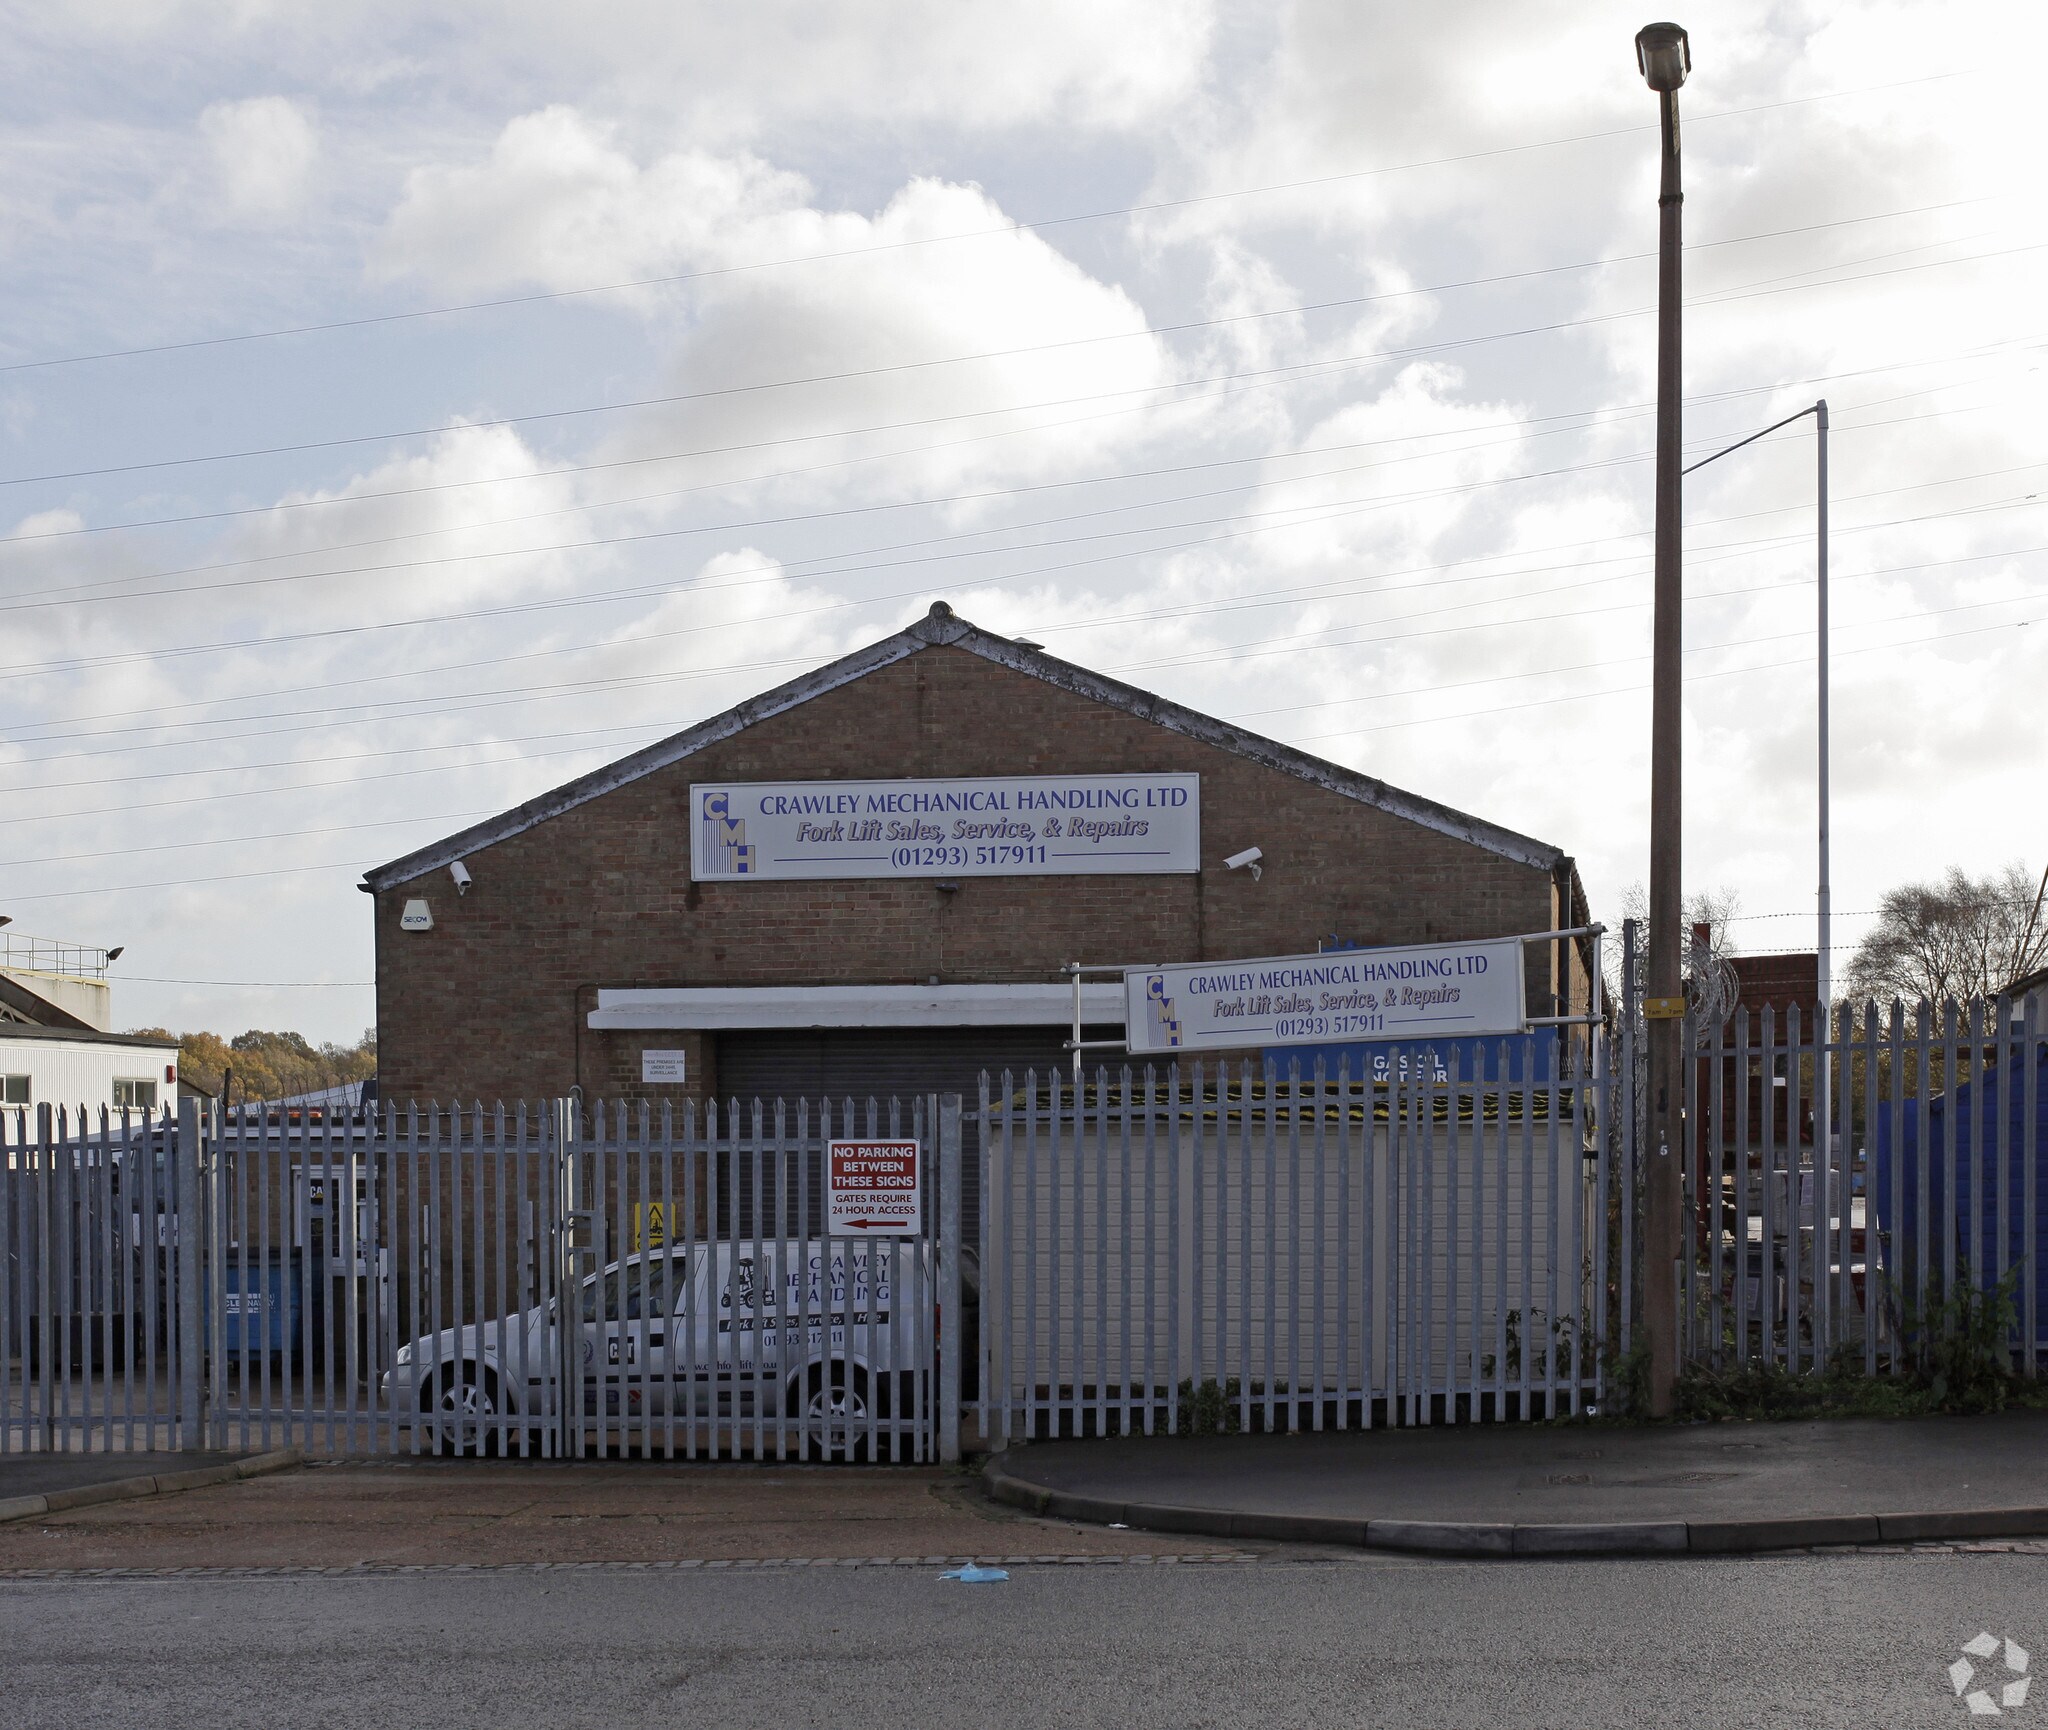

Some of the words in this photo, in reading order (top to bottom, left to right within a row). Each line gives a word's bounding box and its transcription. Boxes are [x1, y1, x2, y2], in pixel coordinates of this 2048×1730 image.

[760, 794, 860, 815] CRAWLEY
[866, 791, 1010, 813] MECHANICAL
[1017, 788, 1139, 810] HANDLING
[1146, 787, 1188, 807] LTD
[796, 819, 845, 842] Fork
[847, 818, 883, 842] Lift
[885, 817, 946, 844] Sales,
[951, 816, 1036, 842] Service,
[1041, 816, 1063, 838] &
[1066, 814, 1150, 843] Repairs
[891, 846, 968, 869] (01293)
[975, 845, 1046, 865] 517911
[1189, 973, 1256, 994] CRAWLEY
[1259, 965, 1359, 989] MECHANICAL
[1364, 957, 1452, 982] HANDLING
[1457, 955, 1488, 975] LTD
[1213, 996, 1245, 1018] Fork
[1247, 994, 1271, 1015] Lift
[1273, 992, 1315, 1015] Sales,
[1318, 989, 1379, 1012] Service,
[1382, 987, 1398, 1007] &
[1400, 982, 1461, 1011] Repairs
[1275, 1017, 1329, 1039] (01293)
[1333, 1014, 1383, 1033] 517911
[1373, 1055, 1408, 1069] GS
[1416, 1054, 1444, 1068] OL
[1416, 1070, 1448, 1082] FR
[833, 1147, 854, 1158] NO
[857, 1147, 913, 1158] PARKING
[843, 1161, 904, 1172] BETWEEN
[833, 1176, 873, 1187] THESE
[876, 1176, 914, 1187] SIGNS
[835, 1194, 867, 1203] GATES
[869, 1194, 912, 1204] REQUIRE
[832, 1206, 843, 1214] 24
[845, 1206, 875, 1214] HOUR
[877, 1206, 916, 1214] ACCESS
[809, 1254, 890, 1269] CAWLY
[764, 1333, 800, 1346] 0193
[609, 1342, 634, 1359] CT
